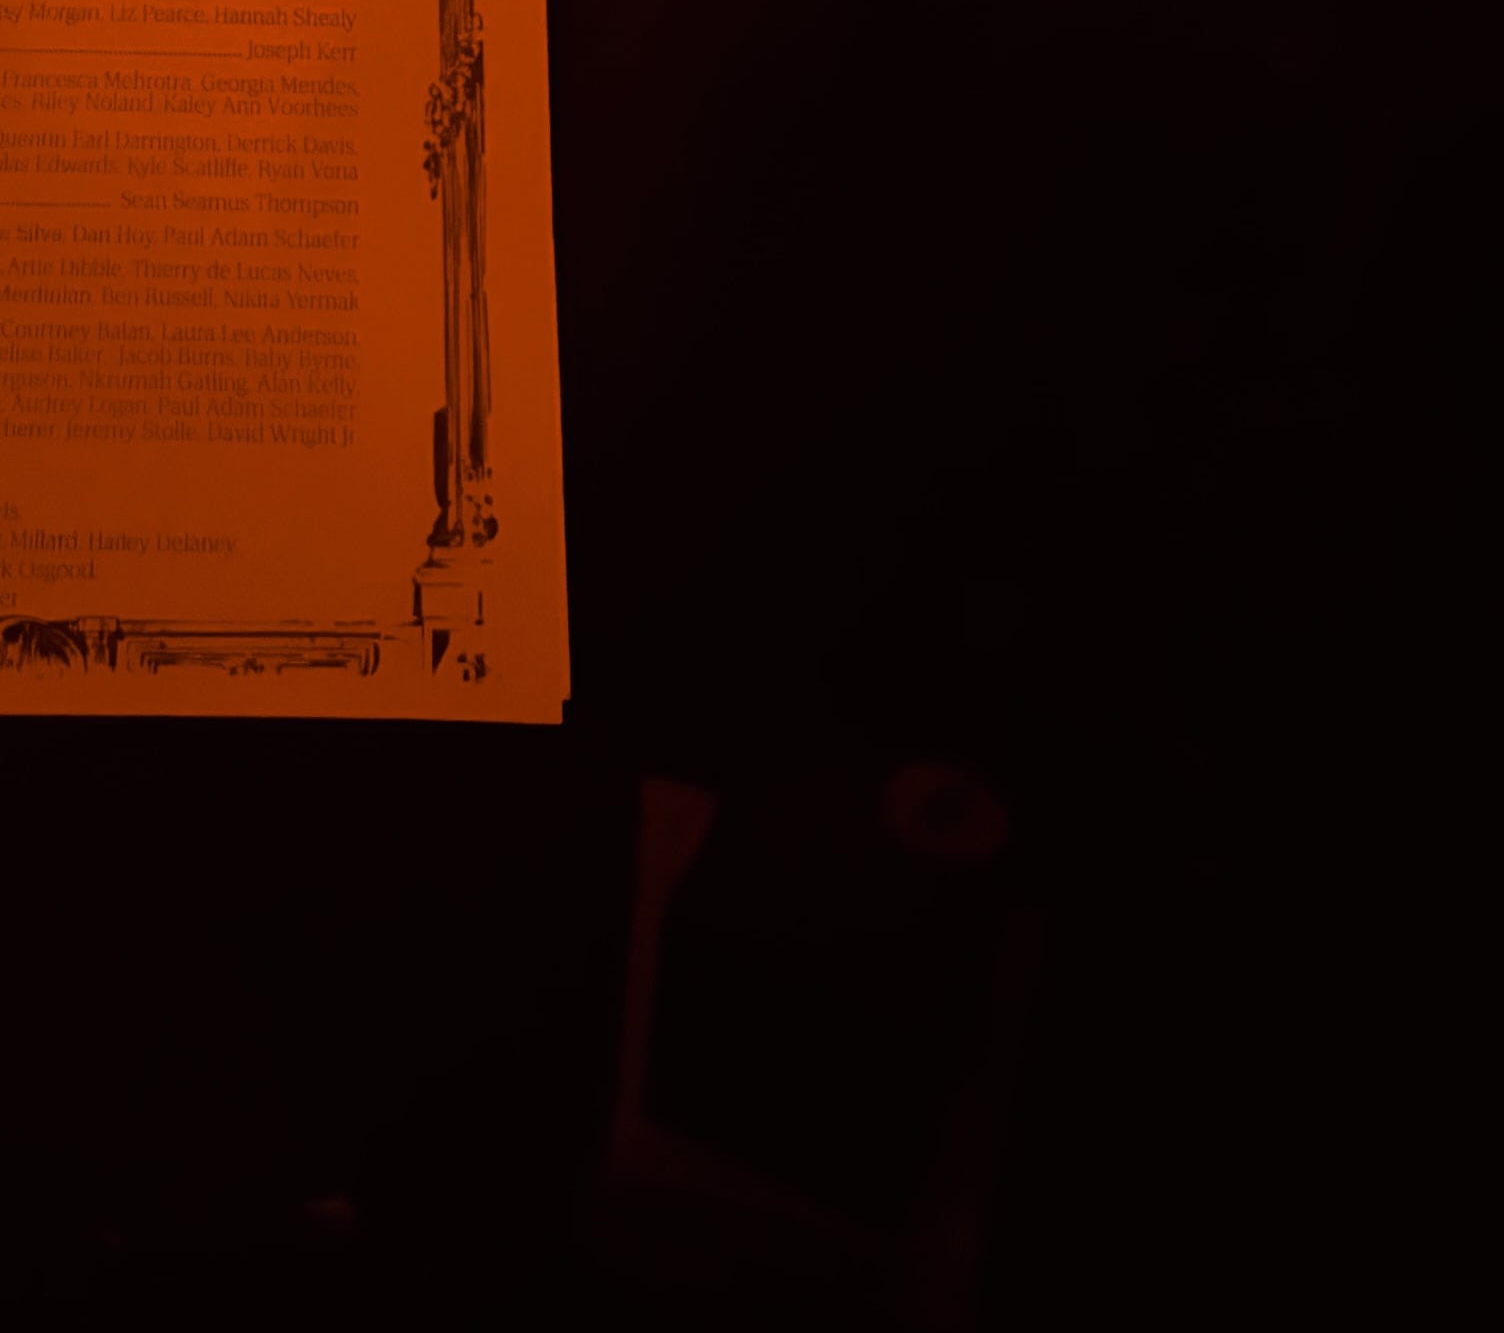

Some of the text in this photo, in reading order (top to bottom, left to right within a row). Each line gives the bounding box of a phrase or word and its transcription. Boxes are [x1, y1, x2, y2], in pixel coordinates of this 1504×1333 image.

[215, 5, 287, 26] Hannah
[293, 8, 357, 32] Shealy
[246, 40, 311, 63] Joseph
[317, 43, 358, 62] Kerr
[201, 73, 274, 96] Georgia
[163, 95, 216, 117] Kaley
[223, 96, 261, 115] Ann
[267, 98, 358, 117] Voorhees
[72, 129, 109, 149] Earl
[227, 133, 296, 154] Derrick
[128, 156, 167, 179] Kyle
[258, 159, 304, 182] Ryan
[120, 189, 167, 210] Sean
[172, 190, 249, 212] Seamus
[253, 193, 358, 218] Thompson
[72, 224, 111, 244] Dan
[164, 226, 204, 246] Paul
[211, 227, 269, 247] Adam
[206, 260, 232, 280] de
[237, 261, 292, 281] Lucas
[102, 286, 138, 306] Ben
[224, 288, 281, 309] Nikita
[287, 290, 358, 311] Yermak
[0, 319, 91, 342] Courtney
[162, 322, 215, 343] Laura
[222, 323, 255, 344] Lee
[119, 344, 172, 366] Jacob
[158, 397, 199, 417] Paul
[207, 397, 264, 418] Adam
[208, 421, 264, 442] David
